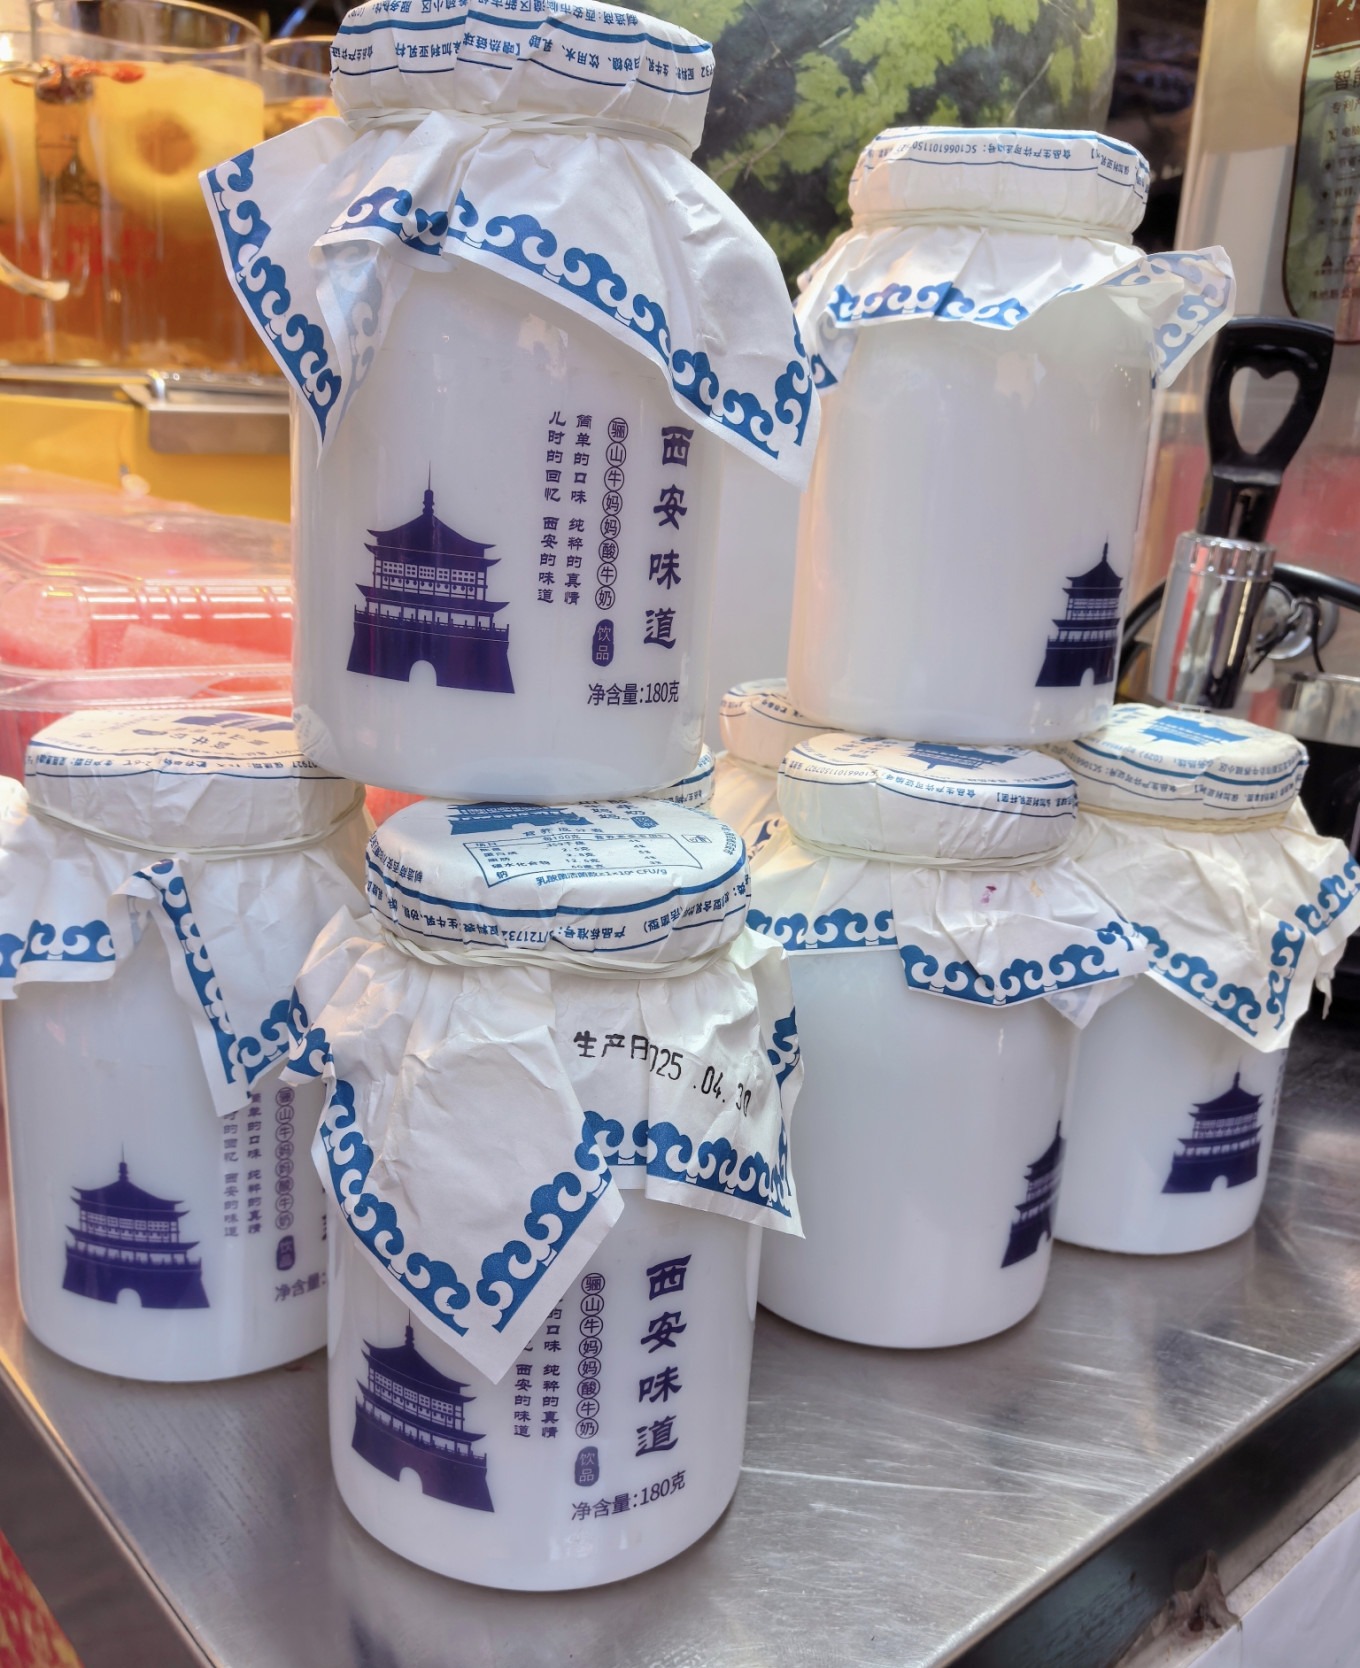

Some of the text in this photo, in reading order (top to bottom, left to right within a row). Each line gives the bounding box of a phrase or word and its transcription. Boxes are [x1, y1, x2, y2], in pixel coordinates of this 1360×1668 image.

[537, 411, 566, 604] 儿时的回忆 西安的味道
[564, 414, 593, 606] 简单的口味 纯粹的真情
[595, 417, 628, 610] 骊山牛妈妈酸牛奶
[643, 425, 694, 650] 西安味道
[587, 680, 680, 706] 净含量:180克
[592, 621, 613, 665] 饮品
[513, 1363, 533, 1438] 西安的味道
[575, 1272, 606, 1440] 骊山牛妈妈酸牛奶
[634, 1253, 692, 1458] 西安味道
[570, 1470, 687, 1522] 净含量:180克
[576, 1449, 598, 1486] 饮品
